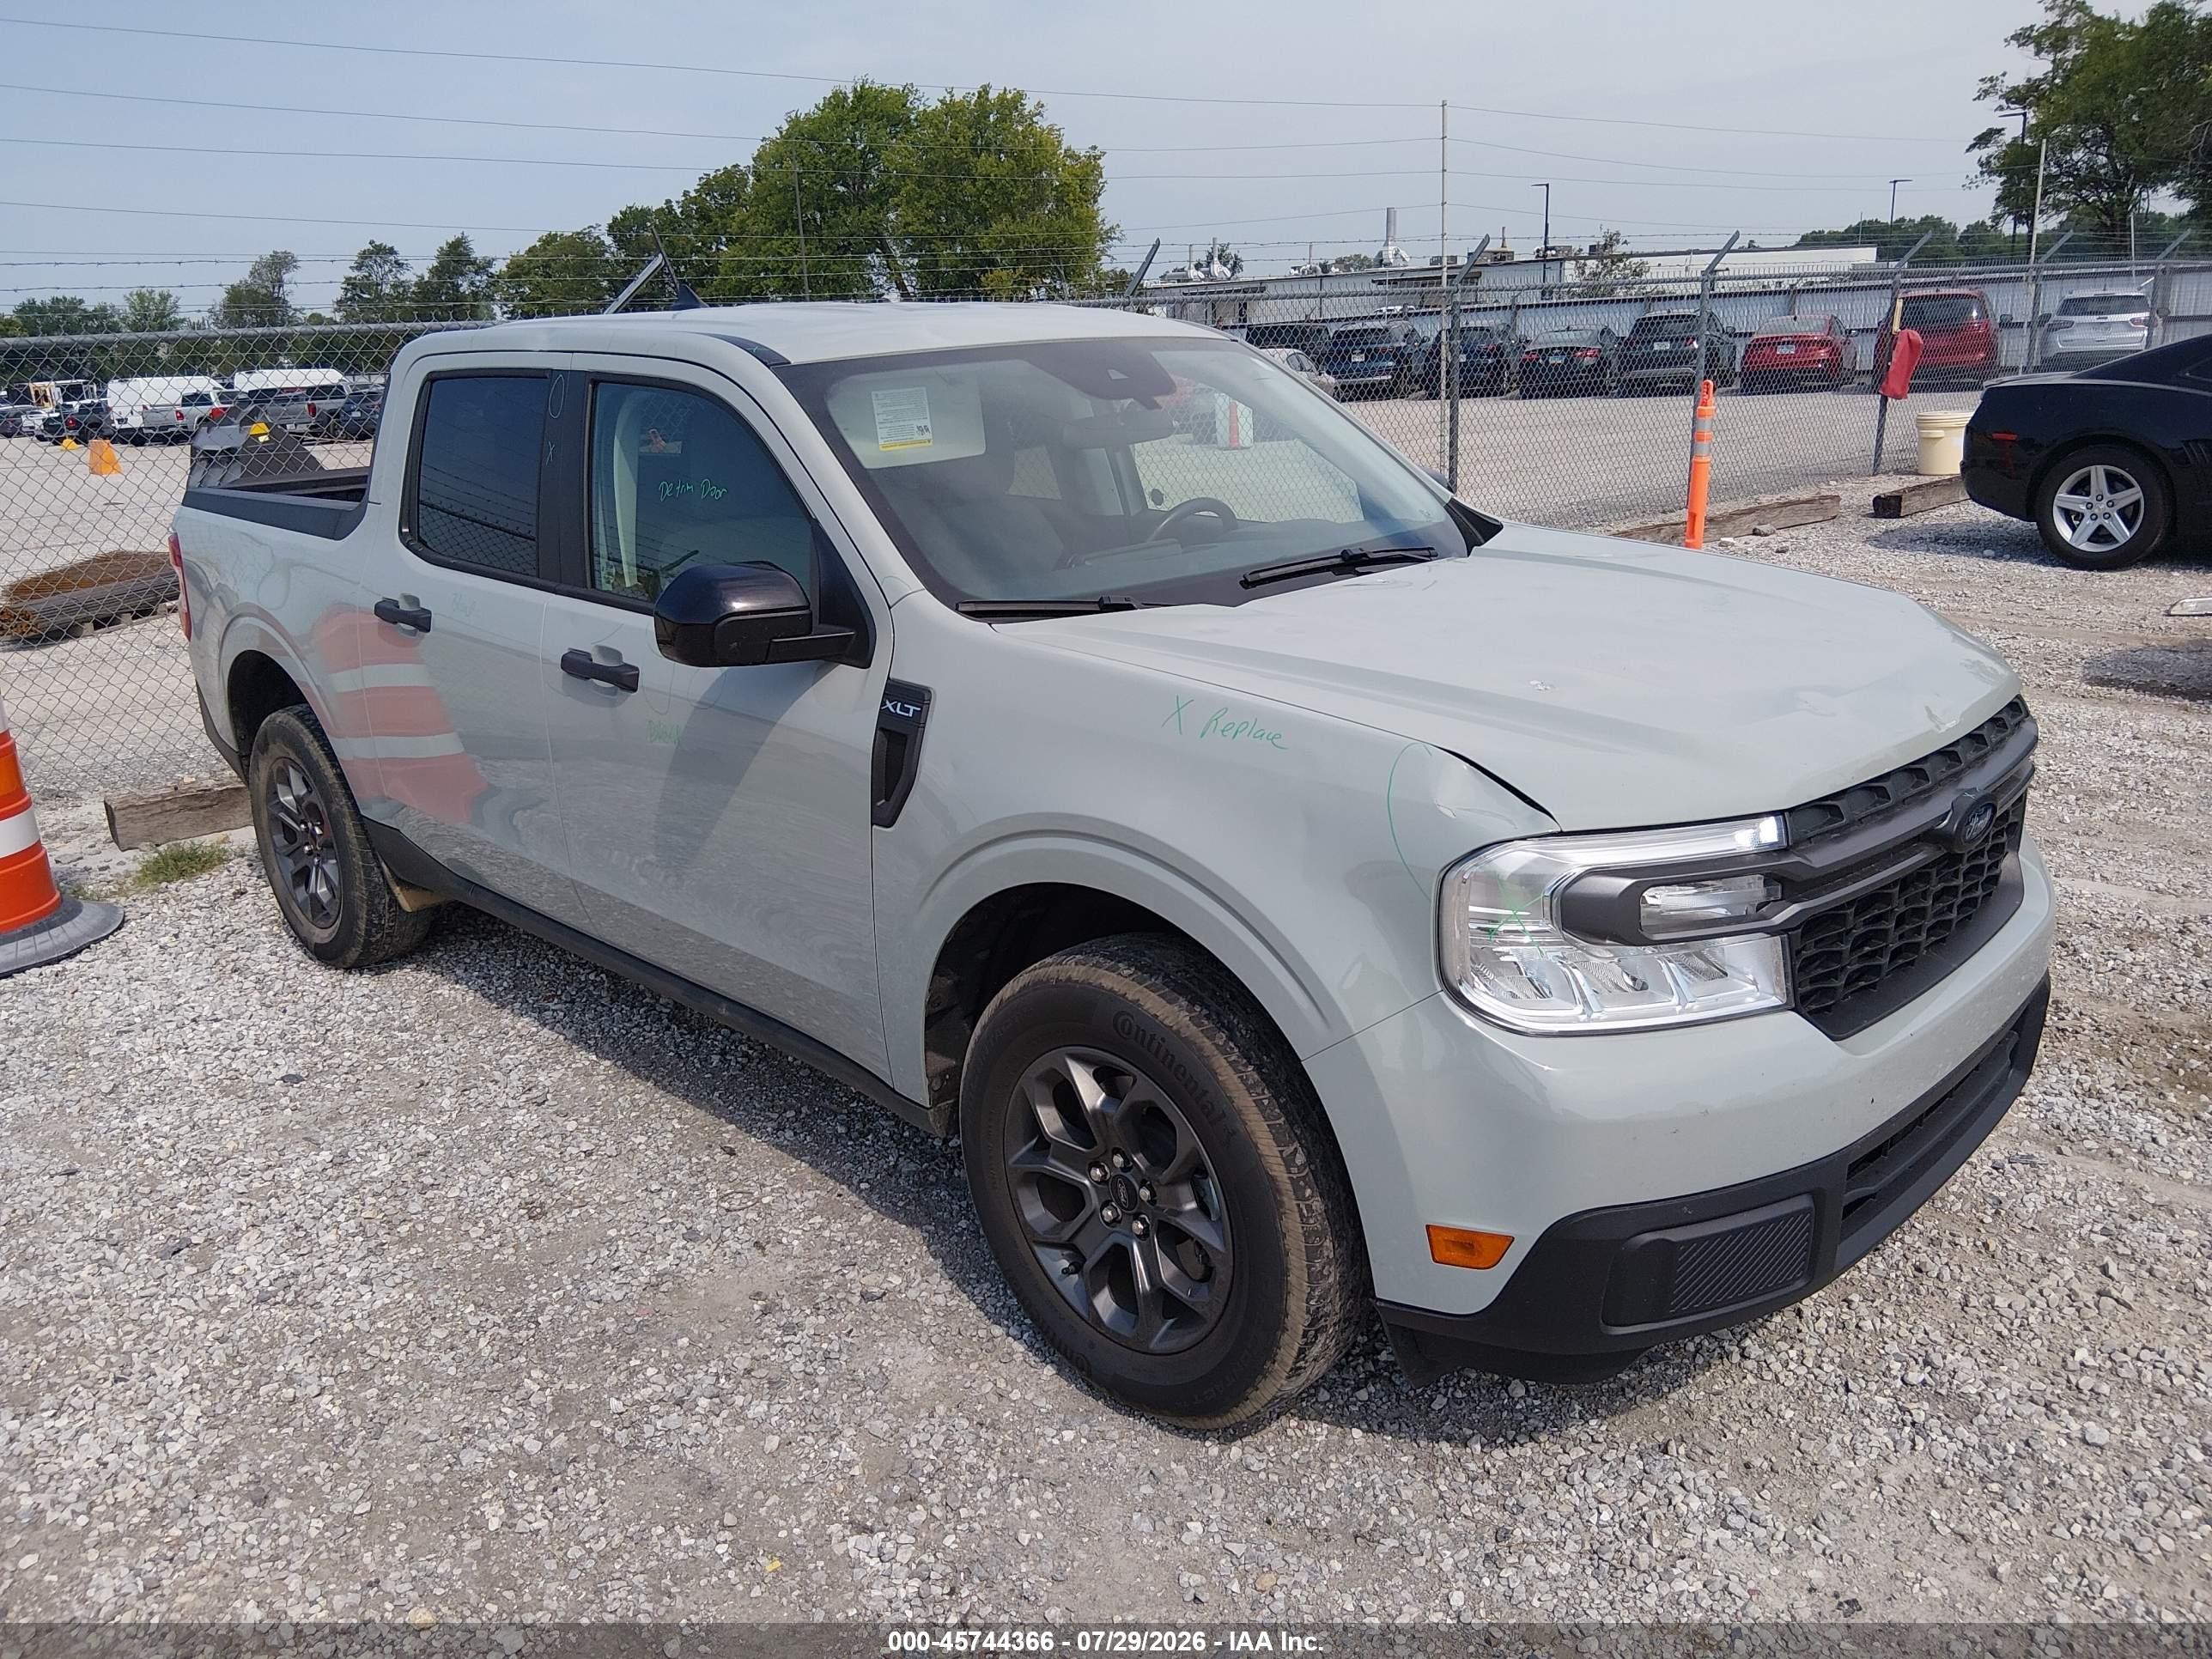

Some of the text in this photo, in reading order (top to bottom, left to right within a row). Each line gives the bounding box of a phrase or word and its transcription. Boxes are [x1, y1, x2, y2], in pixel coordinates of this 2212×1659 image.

[881, 699, 921, 717] XLT
[1200, 707, 1289, 750] Replace
[1112, 1010, 1227, 1125] Continental
